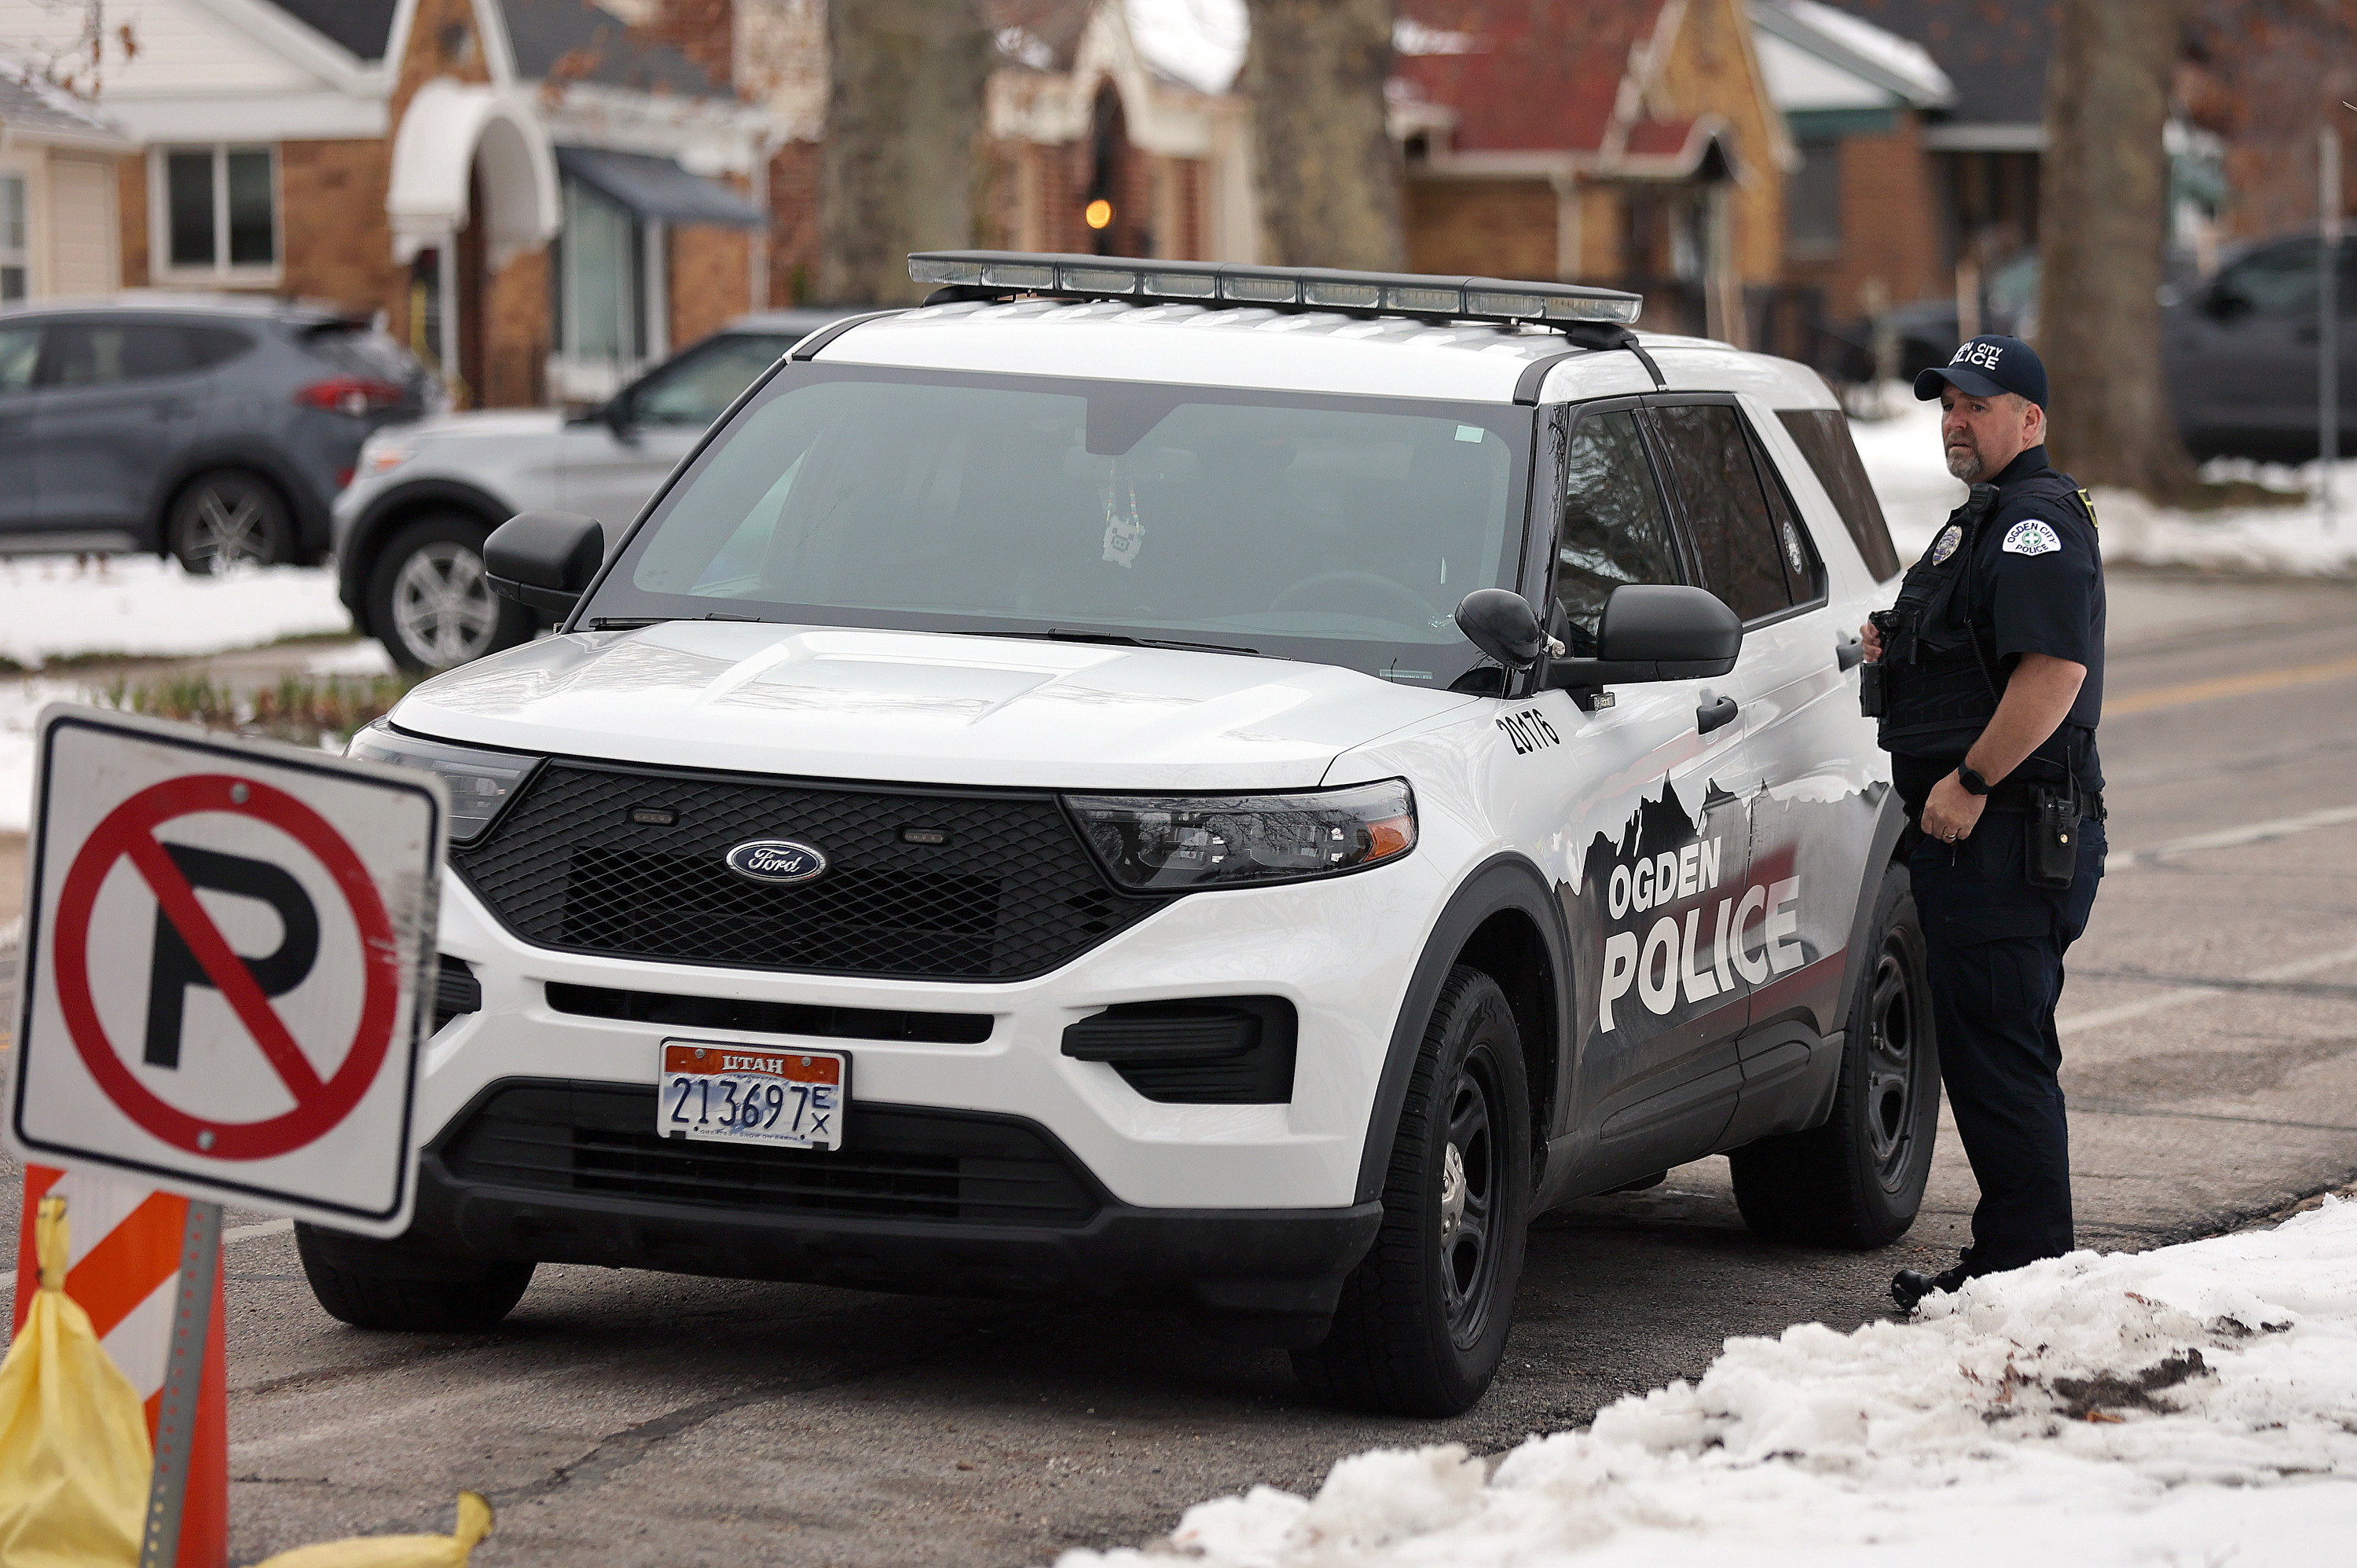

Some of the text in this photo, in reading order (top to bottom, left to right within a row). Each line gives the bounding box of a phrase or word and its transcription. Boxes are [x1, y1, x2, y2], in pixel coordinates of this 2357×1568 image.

[1948, 350, 2000, 370] OLICE
[1977, 343, 2003, 357] CITY
[2007, 522, 2057, 544] OGDEN CITY
[2015, 544, 2049, 554] POLICE
[1495, 708, 1560, 755] 20176
[748, 848, 803, 873] Ford
[1608, 836, 1722, 921] OGDEN
[1599, 875, 1805, 1034] POLICE
[721, 1055, 784, 1075] UTAH
